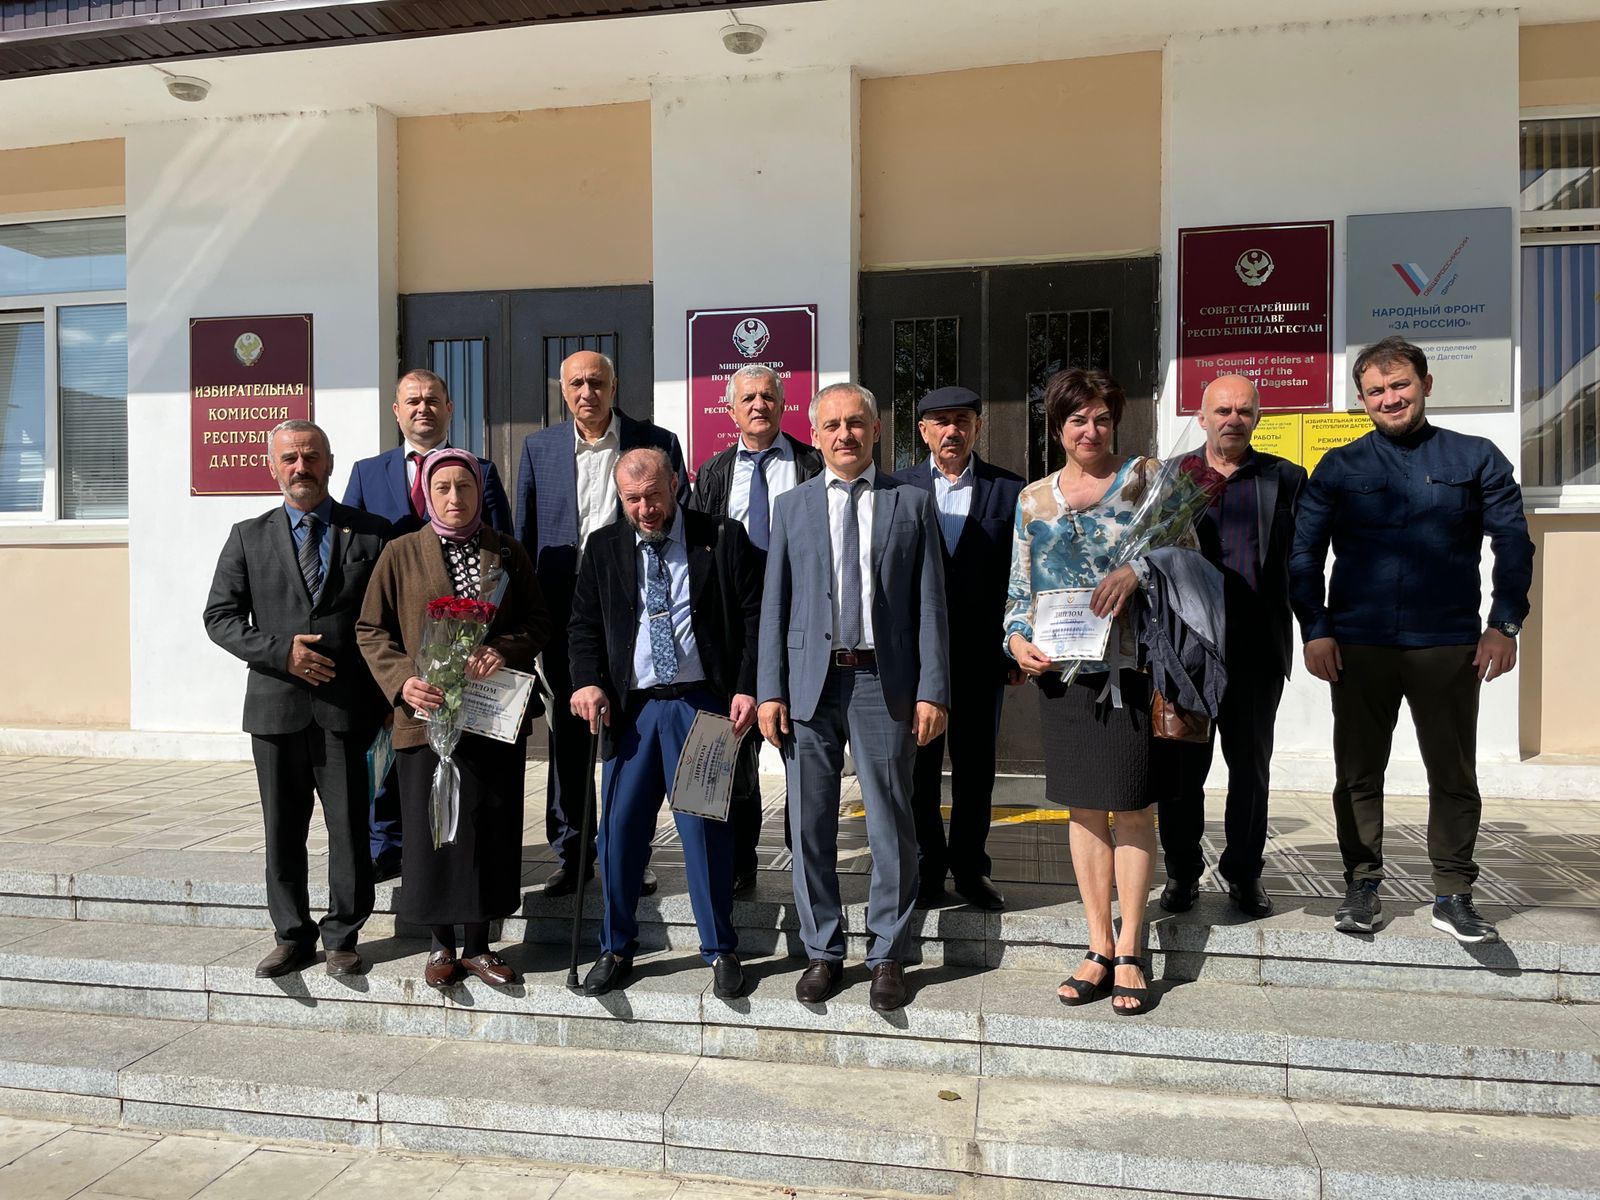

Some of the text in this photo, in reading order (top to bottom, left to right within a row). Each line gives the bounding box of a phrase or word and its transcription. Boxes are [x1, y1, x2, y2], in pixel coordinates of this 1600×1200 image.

[1200, 302, 1310, 315] СОВЕТ СТАРЕЙШИН
[1372, 304, 1486, 317] НАРОДНЫЙ ФРОНТ
[1225, 314, 1285, 325] ПРИ ГЛАВЕ
[1389, 318, 1471, 330] «ЗА РОССИЮ»
[1187, 324, 1323, 338] РЕСПУБЛИКИ ДАГЕСТАН
[1195, 355, 1315, 367] The Council of elders at
[1216, 366, 1293, 377] the Head of the
[1261, 378, 1308, 388] Dagestan
[195, 383, 304, 398] ИЗБИРАТЕЛЬНАЯ
[208, 406, 289, 421] КОМИССИЯ
[209, 454, 269, 468] ДАГЕСТ
